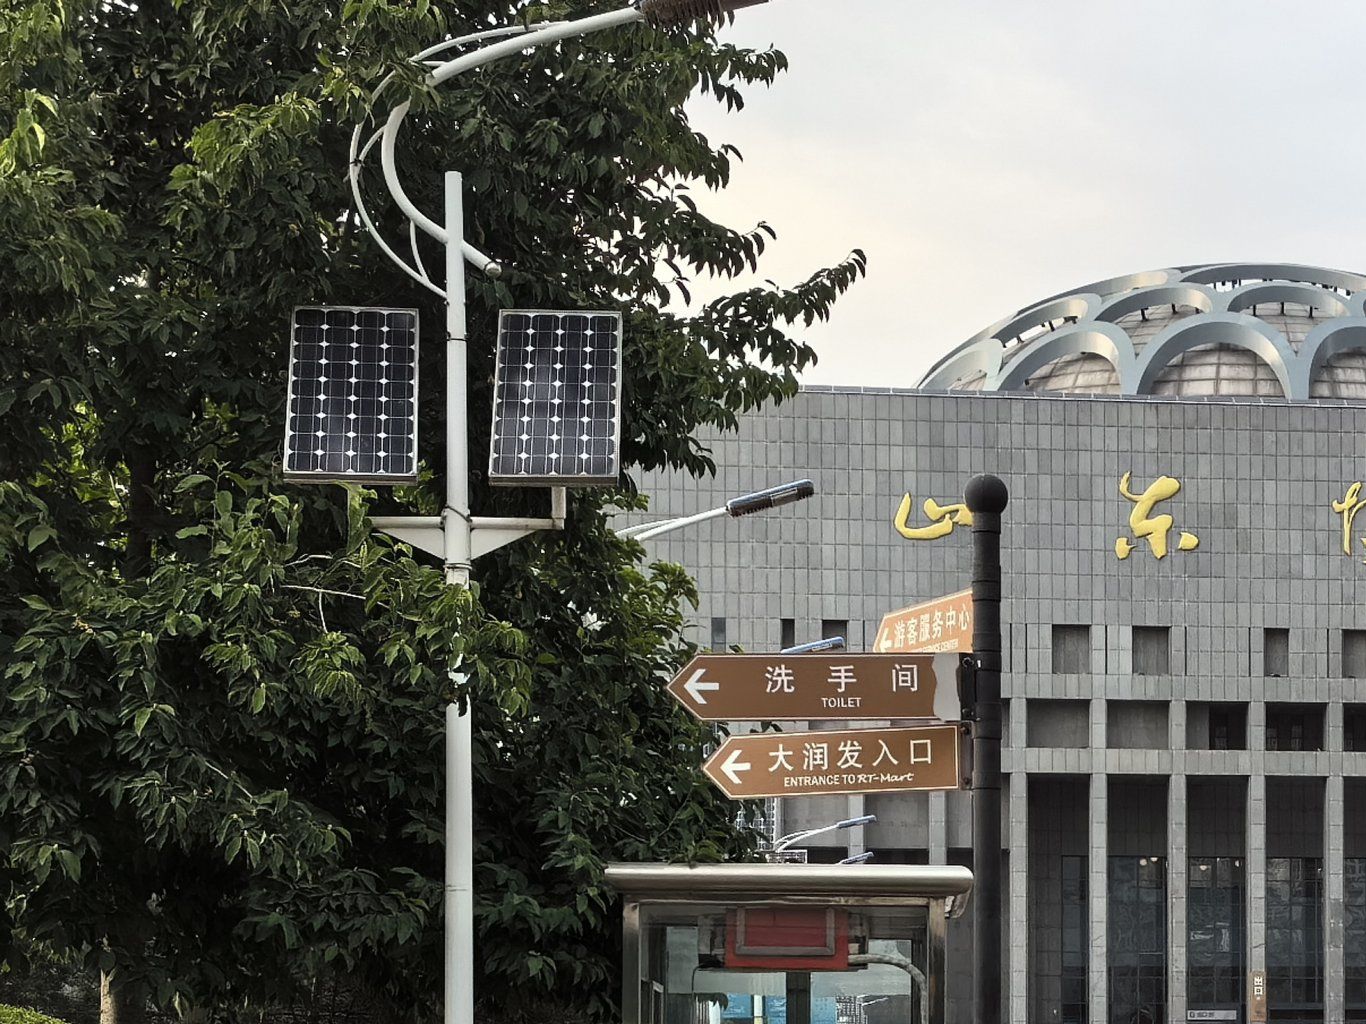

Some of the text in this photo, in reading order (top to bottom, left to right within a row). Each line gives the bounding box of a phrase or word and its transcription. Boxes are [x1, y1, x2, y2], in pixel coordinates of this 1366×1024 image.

[894, 603, 970, 648] 游客服务中心
[765, 664, 918, 693] 洗手间
[821, 697, 862, 708] TOILET
[768, 739, 931, 772] 大润发入口
[784, 772, 914, 788] ENTRANCE TO RT-Mart
[1253, 976, 1263, 995] 出口
